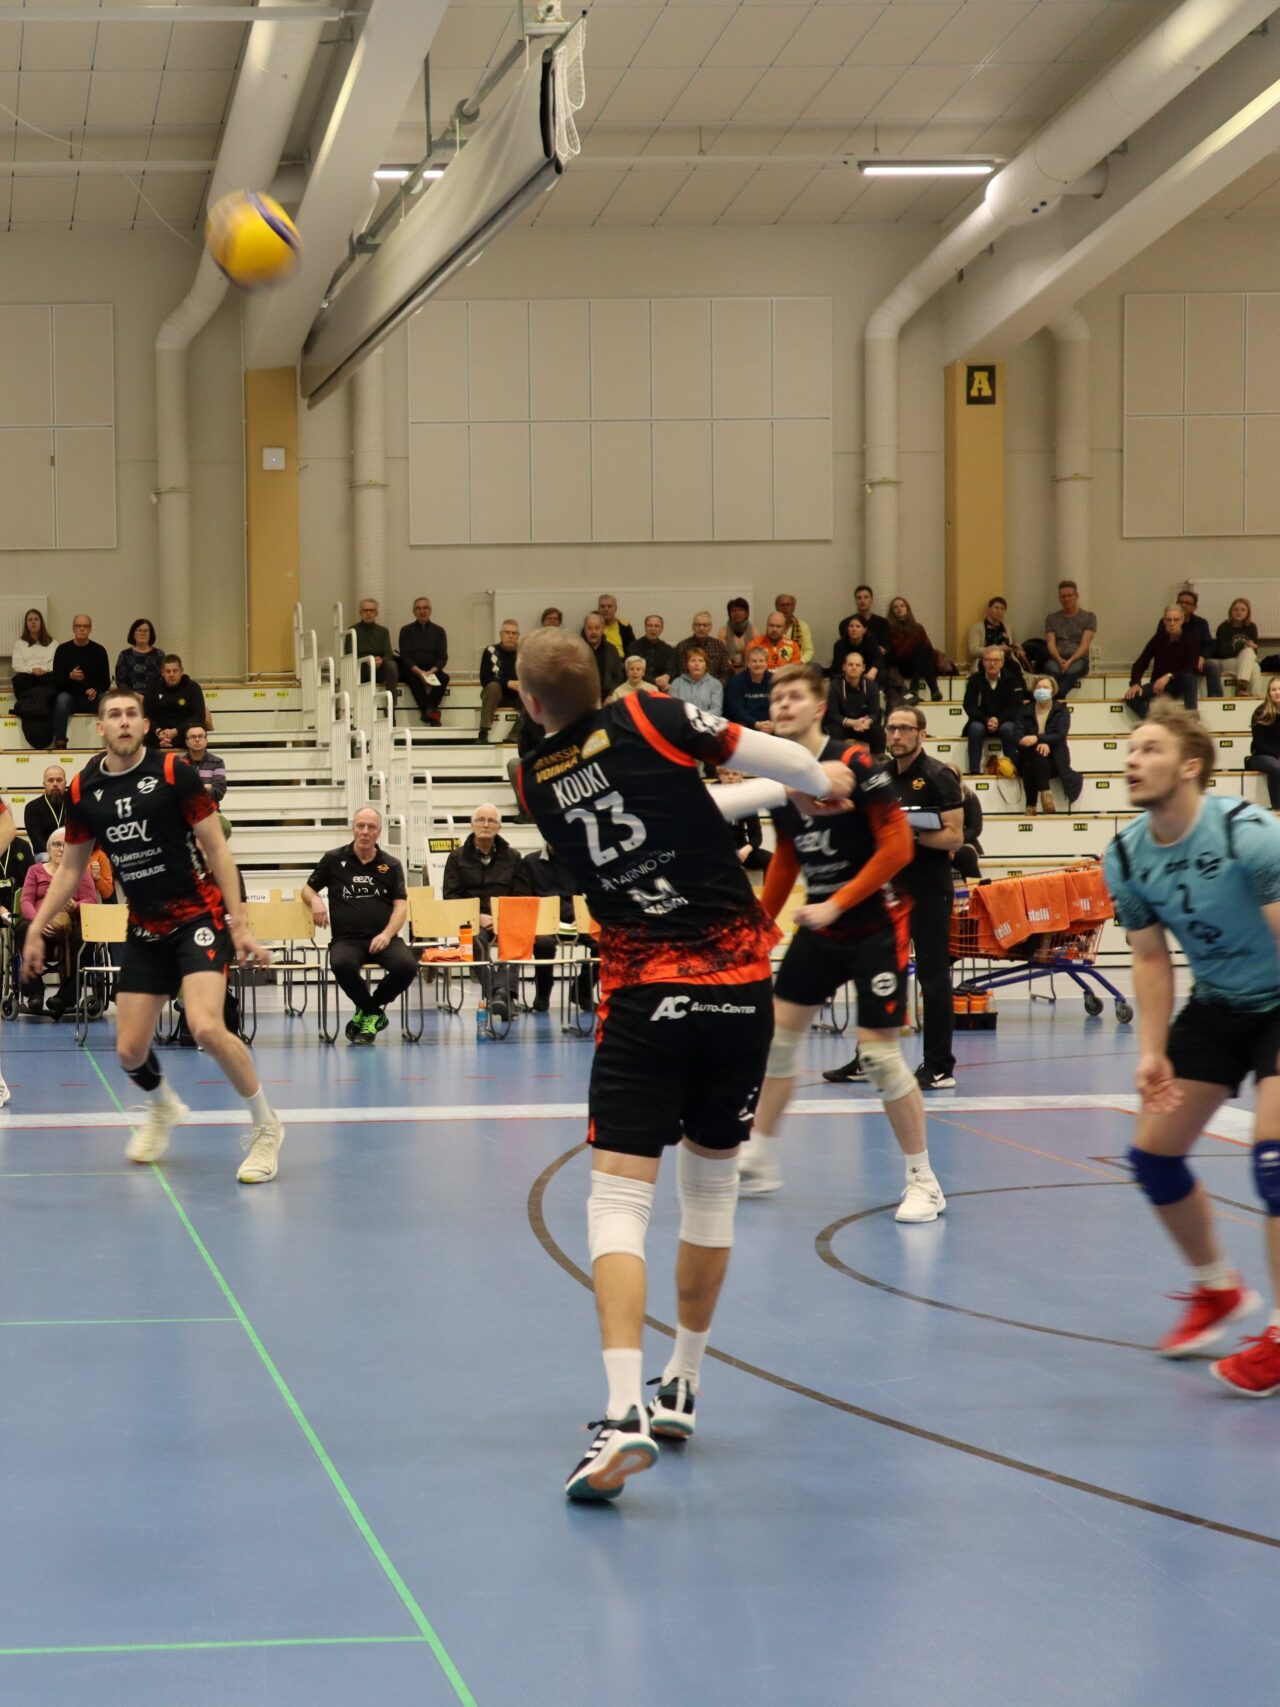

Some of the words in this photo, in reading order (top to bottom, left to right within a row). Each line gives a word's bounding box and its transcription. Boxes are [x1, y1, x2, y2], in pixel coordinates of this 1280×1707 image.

[970, 371, 992, 397] A
[552, 762, 611, 809] KOUKI
[114, 797, 132, 818] 13
[106, 819, 153, 843] eezy
[564, 791, 647, 867] 23
[352, 875, 375, 886] eezy
[650, 995, 691, 1021] AC
